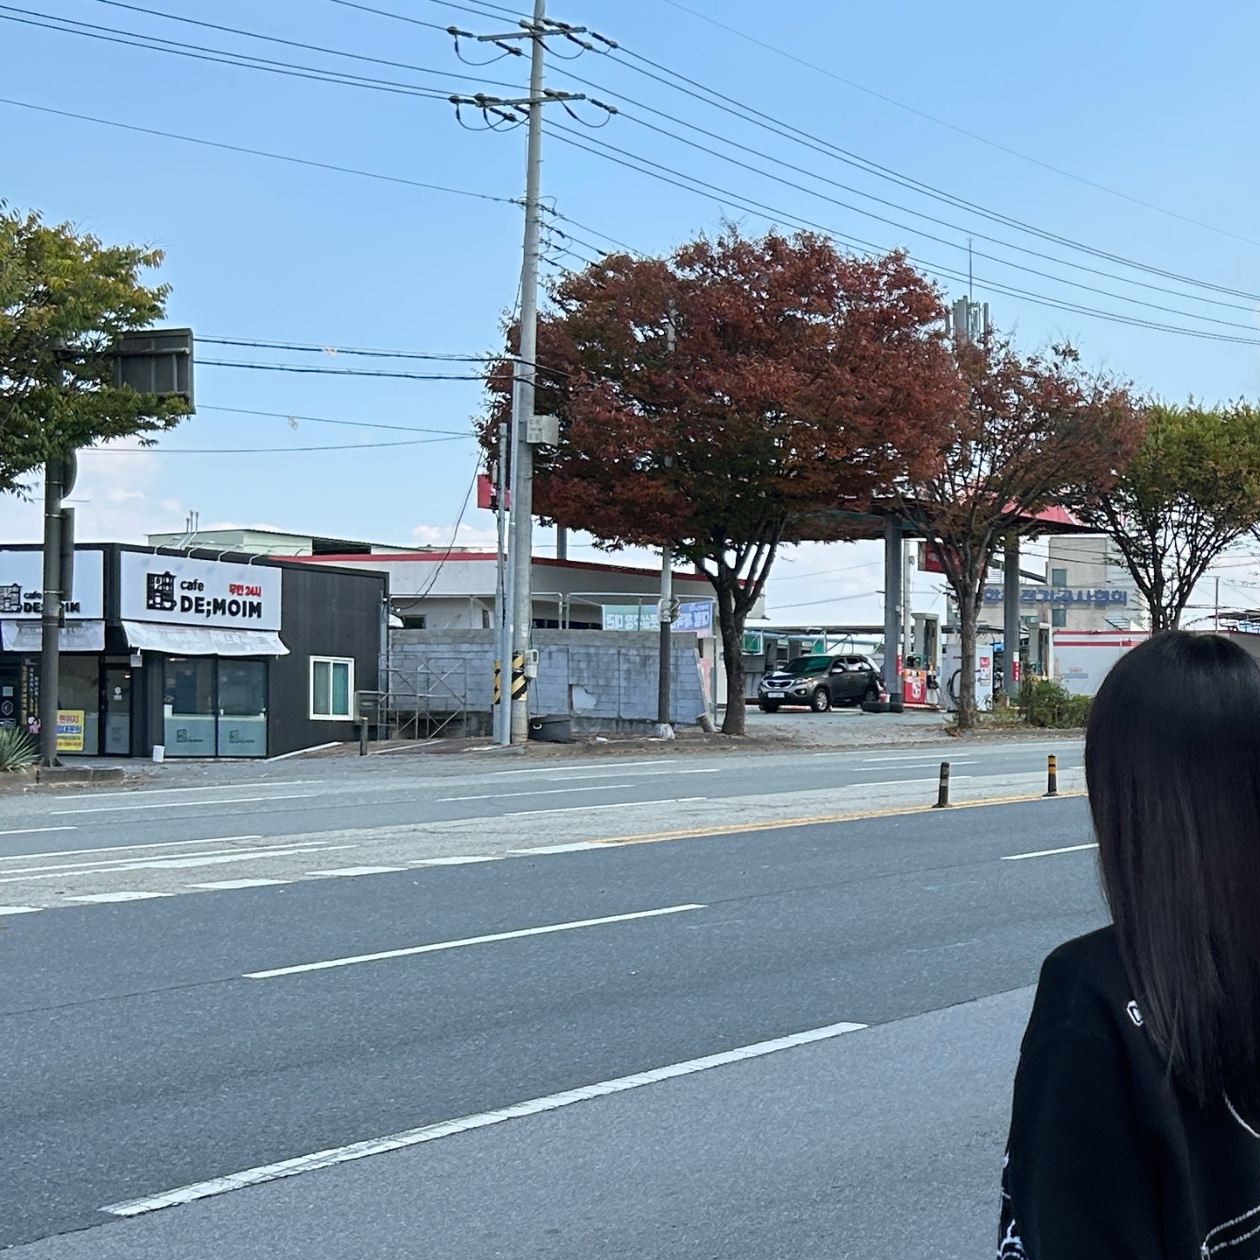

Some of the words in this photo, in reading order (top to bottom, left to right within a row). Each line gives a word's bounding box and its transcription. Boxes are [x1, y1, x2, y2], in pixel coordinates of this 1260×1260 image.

[180, 579, 205, 592] cafe
[229, 583, 245, 597] 무인
[245, 585, 262, 597] 24시
[23, 591, 43, 600] cafe
[984, 588, 1128, 606] 한전기공사협회
[180, 595, 262, 619] DE;MOIM
